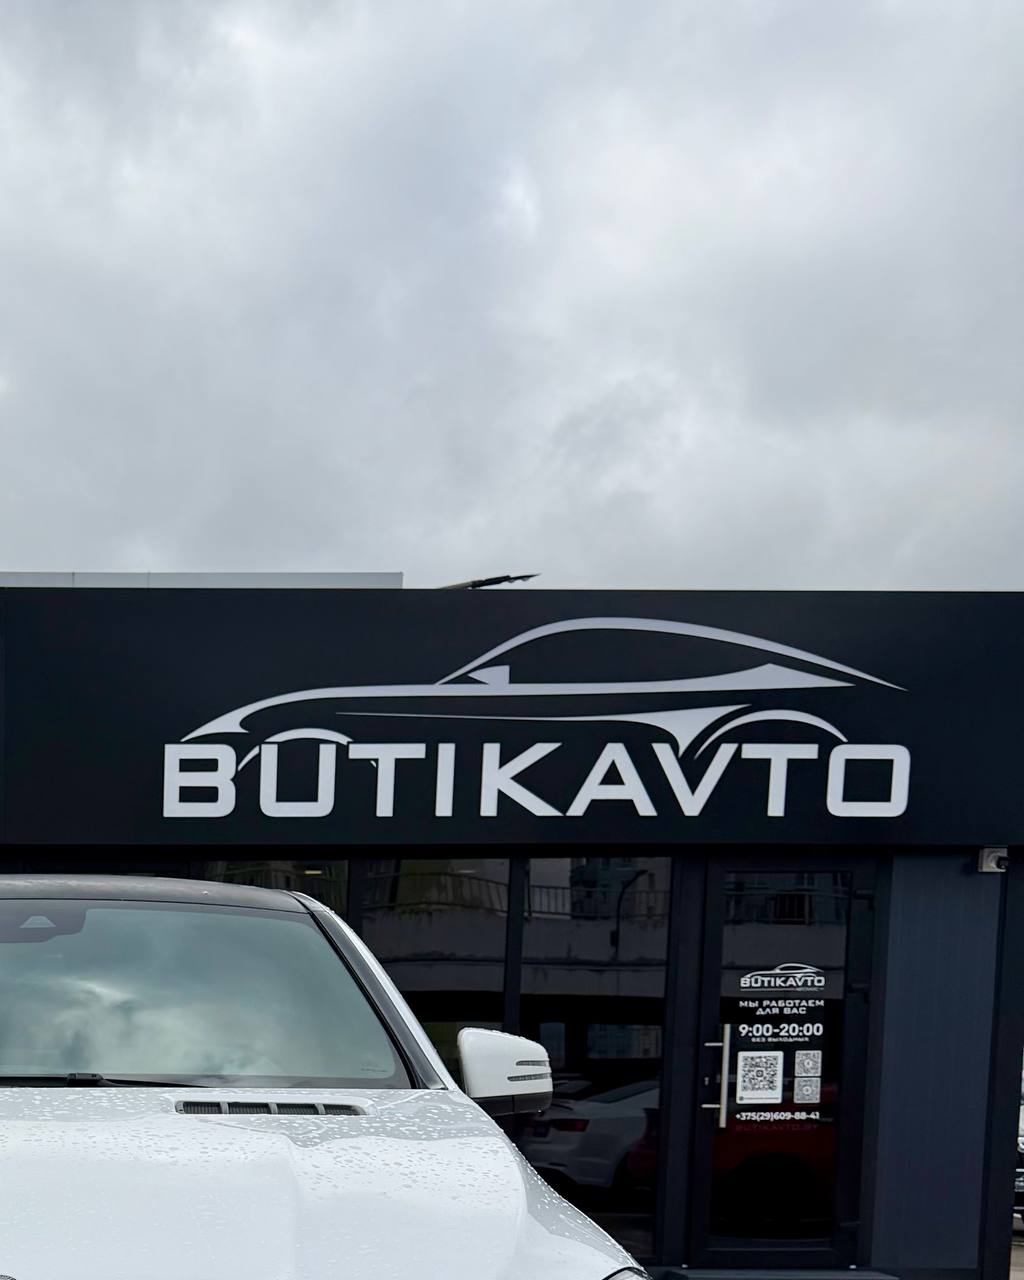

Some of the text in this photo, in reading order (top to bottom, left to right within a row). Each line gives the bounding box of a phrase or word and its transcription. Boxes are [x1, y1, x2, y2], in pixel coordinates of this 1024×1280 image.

[162, 742, 912, 818] BUTIKAVTO
[740, 976, 826, 988] BUTIKAVTO
[739, 1000, 825, 1008] МЫ РАБОТАЕМ
[756, 1007, 808, 1016] ДЛЯ ВАС
[738, 1022, 824, 1037] 9:00-20:00
